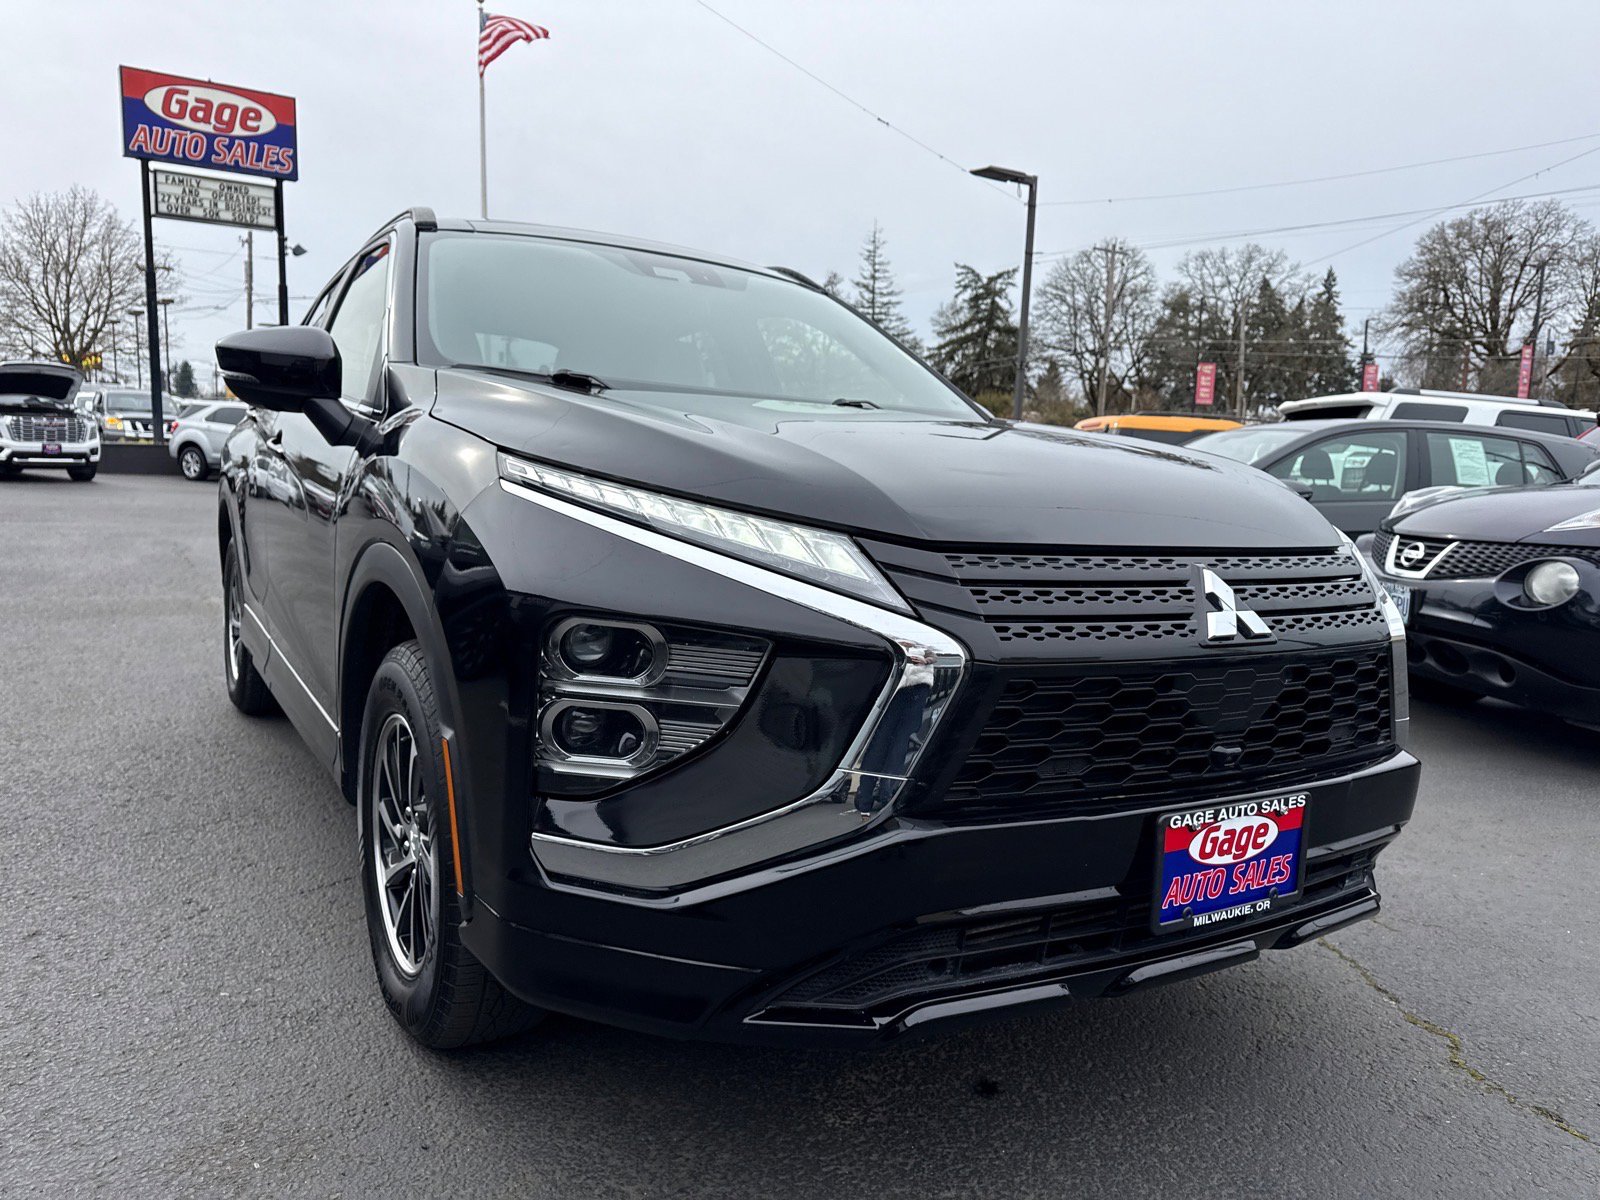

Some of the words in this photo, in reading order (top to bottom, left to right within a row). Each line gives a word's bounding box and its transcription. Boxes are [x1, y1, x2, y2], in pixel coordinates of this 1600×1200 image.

[161, 87, 262, 134] Gage
[129, 124, 207, 161] AUTO
[211, 136, 293, 173] SALES
[165, 175, 201, 188] FAMILY
[219, 182, 249, 195] OWNED
[181, 187, 200, 198] AND
[212, 190, 260, 205] OPERATED!
[160, 193, 171, 203] 27
[175, 195, 204, 208] YEARS
[209, 201, 218, 209] IN
[225, 202, 271, 217] BUSINESS!
[166, 203, 191, 215] OVER
[203, 208, 220, 219] 50K
[232, 213, 259, 224] SOLD!
[1169, 809, 1215, 829] GAGE
[1218, 803, 1258, 822] AUTO
[1260, 795, 1306, 812] SALES
[1198, 822, 1270, 861] Gage
[1161, 867, 1227, 909] AUTO
[1229, 853, 1293, 895] SALES
[1193, 904, 1254, 927] MILWAUKIE,
[1256, 900, 1271, 912] OR
